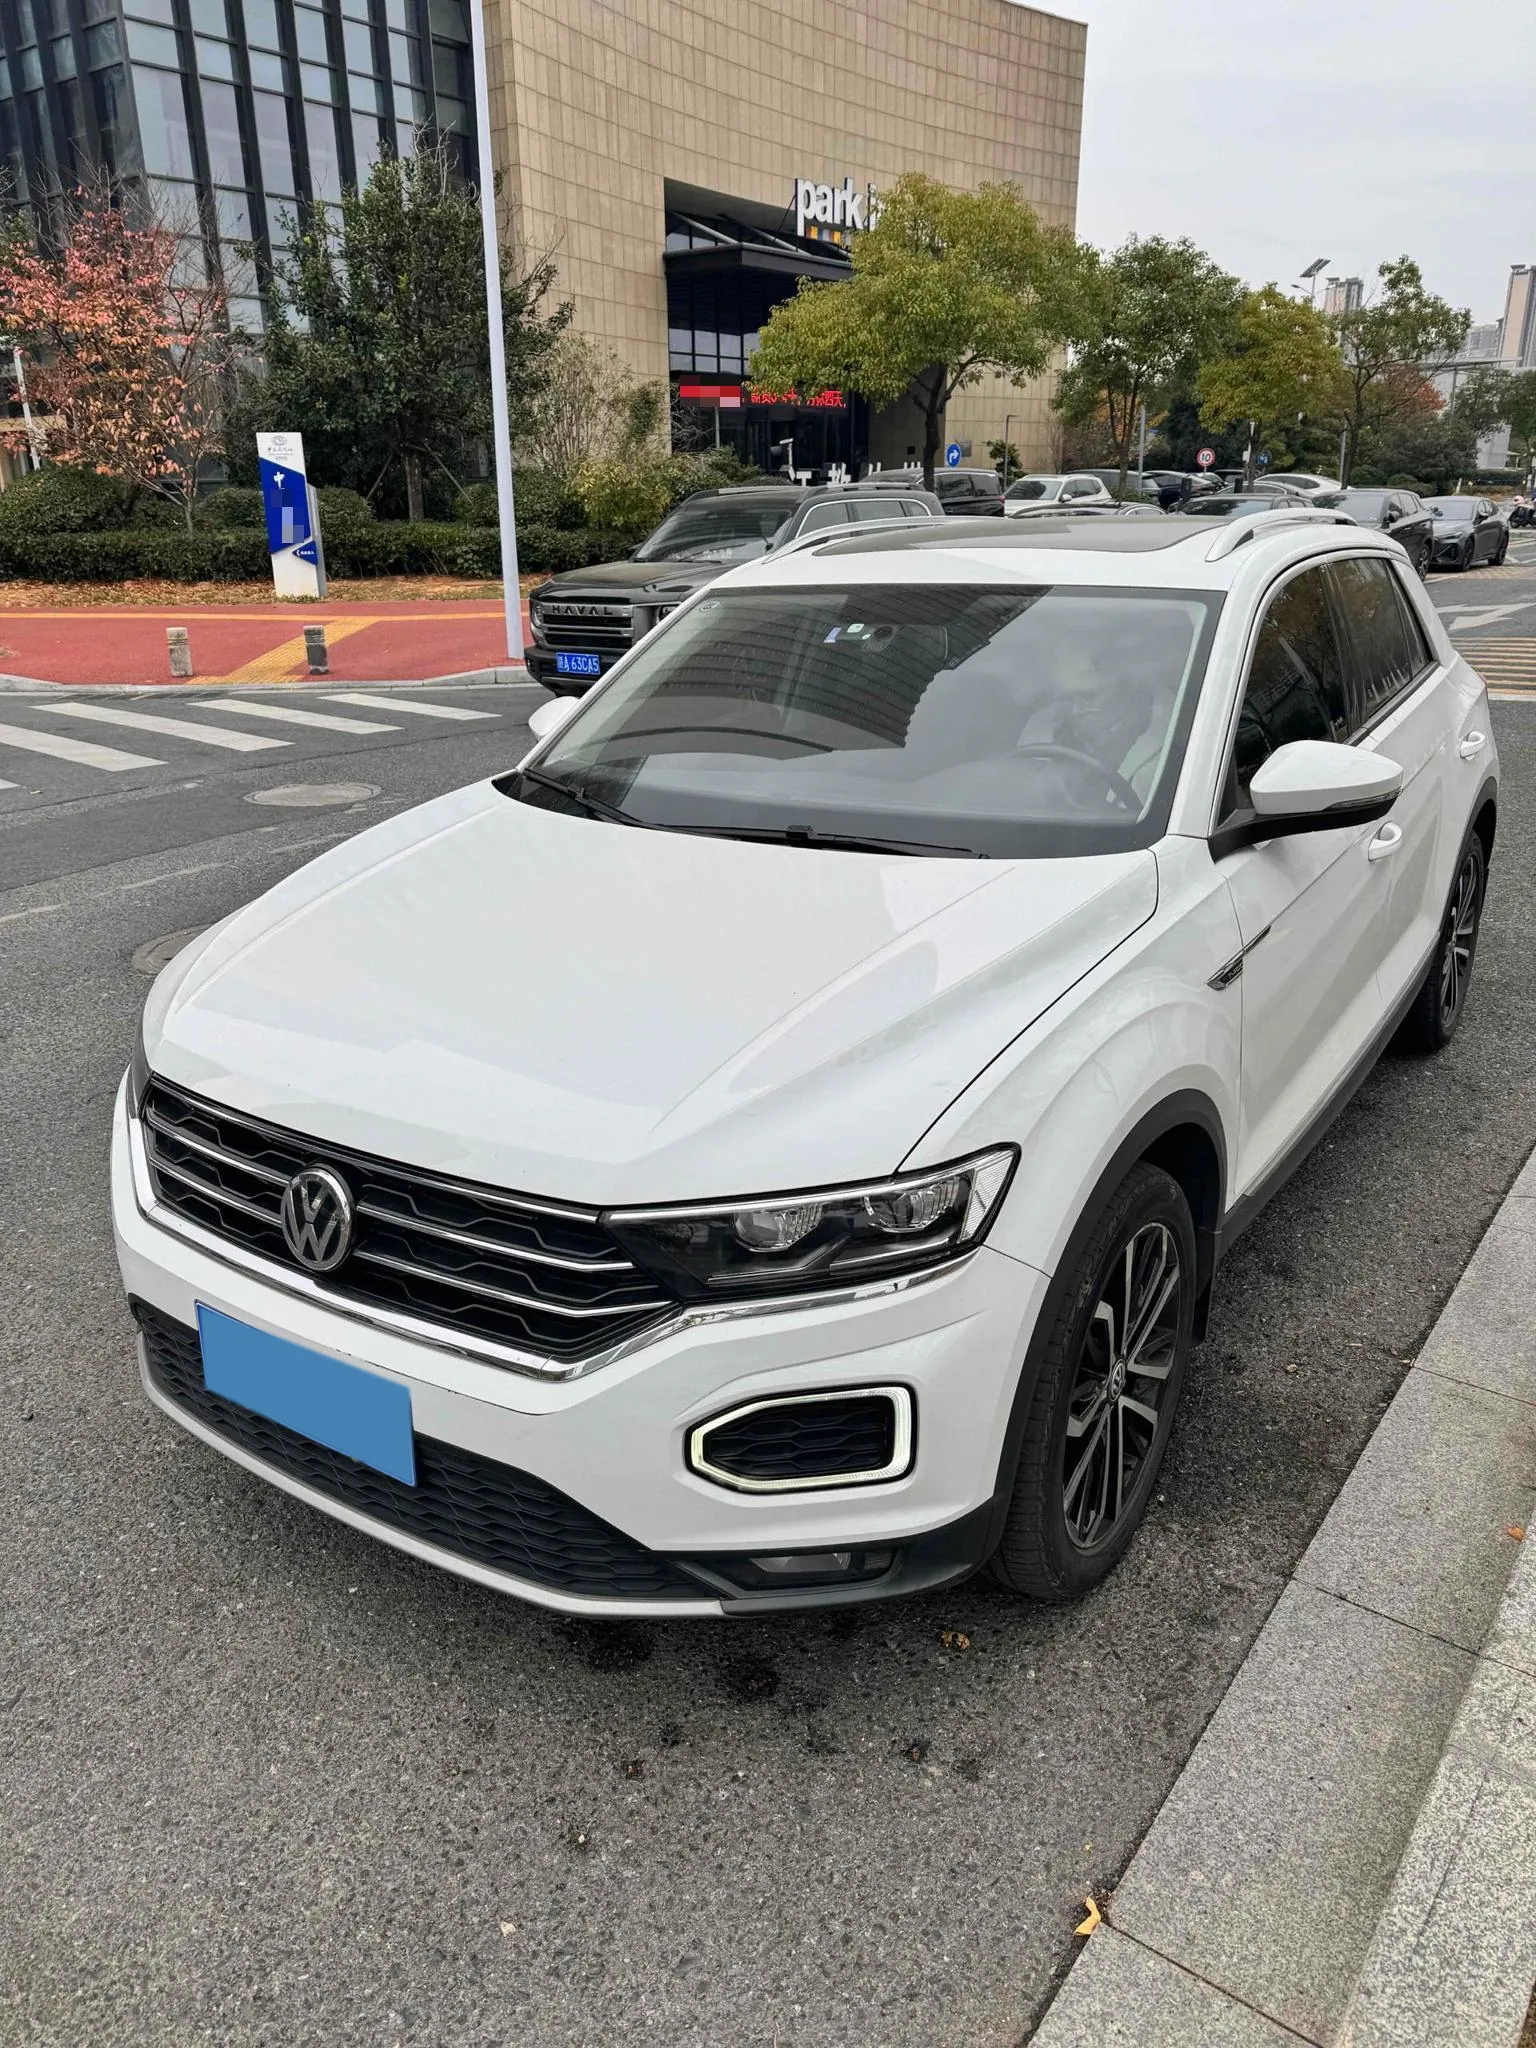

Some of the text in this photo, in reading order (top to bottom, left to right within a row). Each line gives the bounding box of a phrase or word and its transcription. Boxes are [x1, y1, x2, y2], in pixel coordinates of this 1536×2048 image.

[795, 177, 864, 237] park
[1201, 453, 1211, 462] 10
[552, 604, 613, 616] HAVAL
